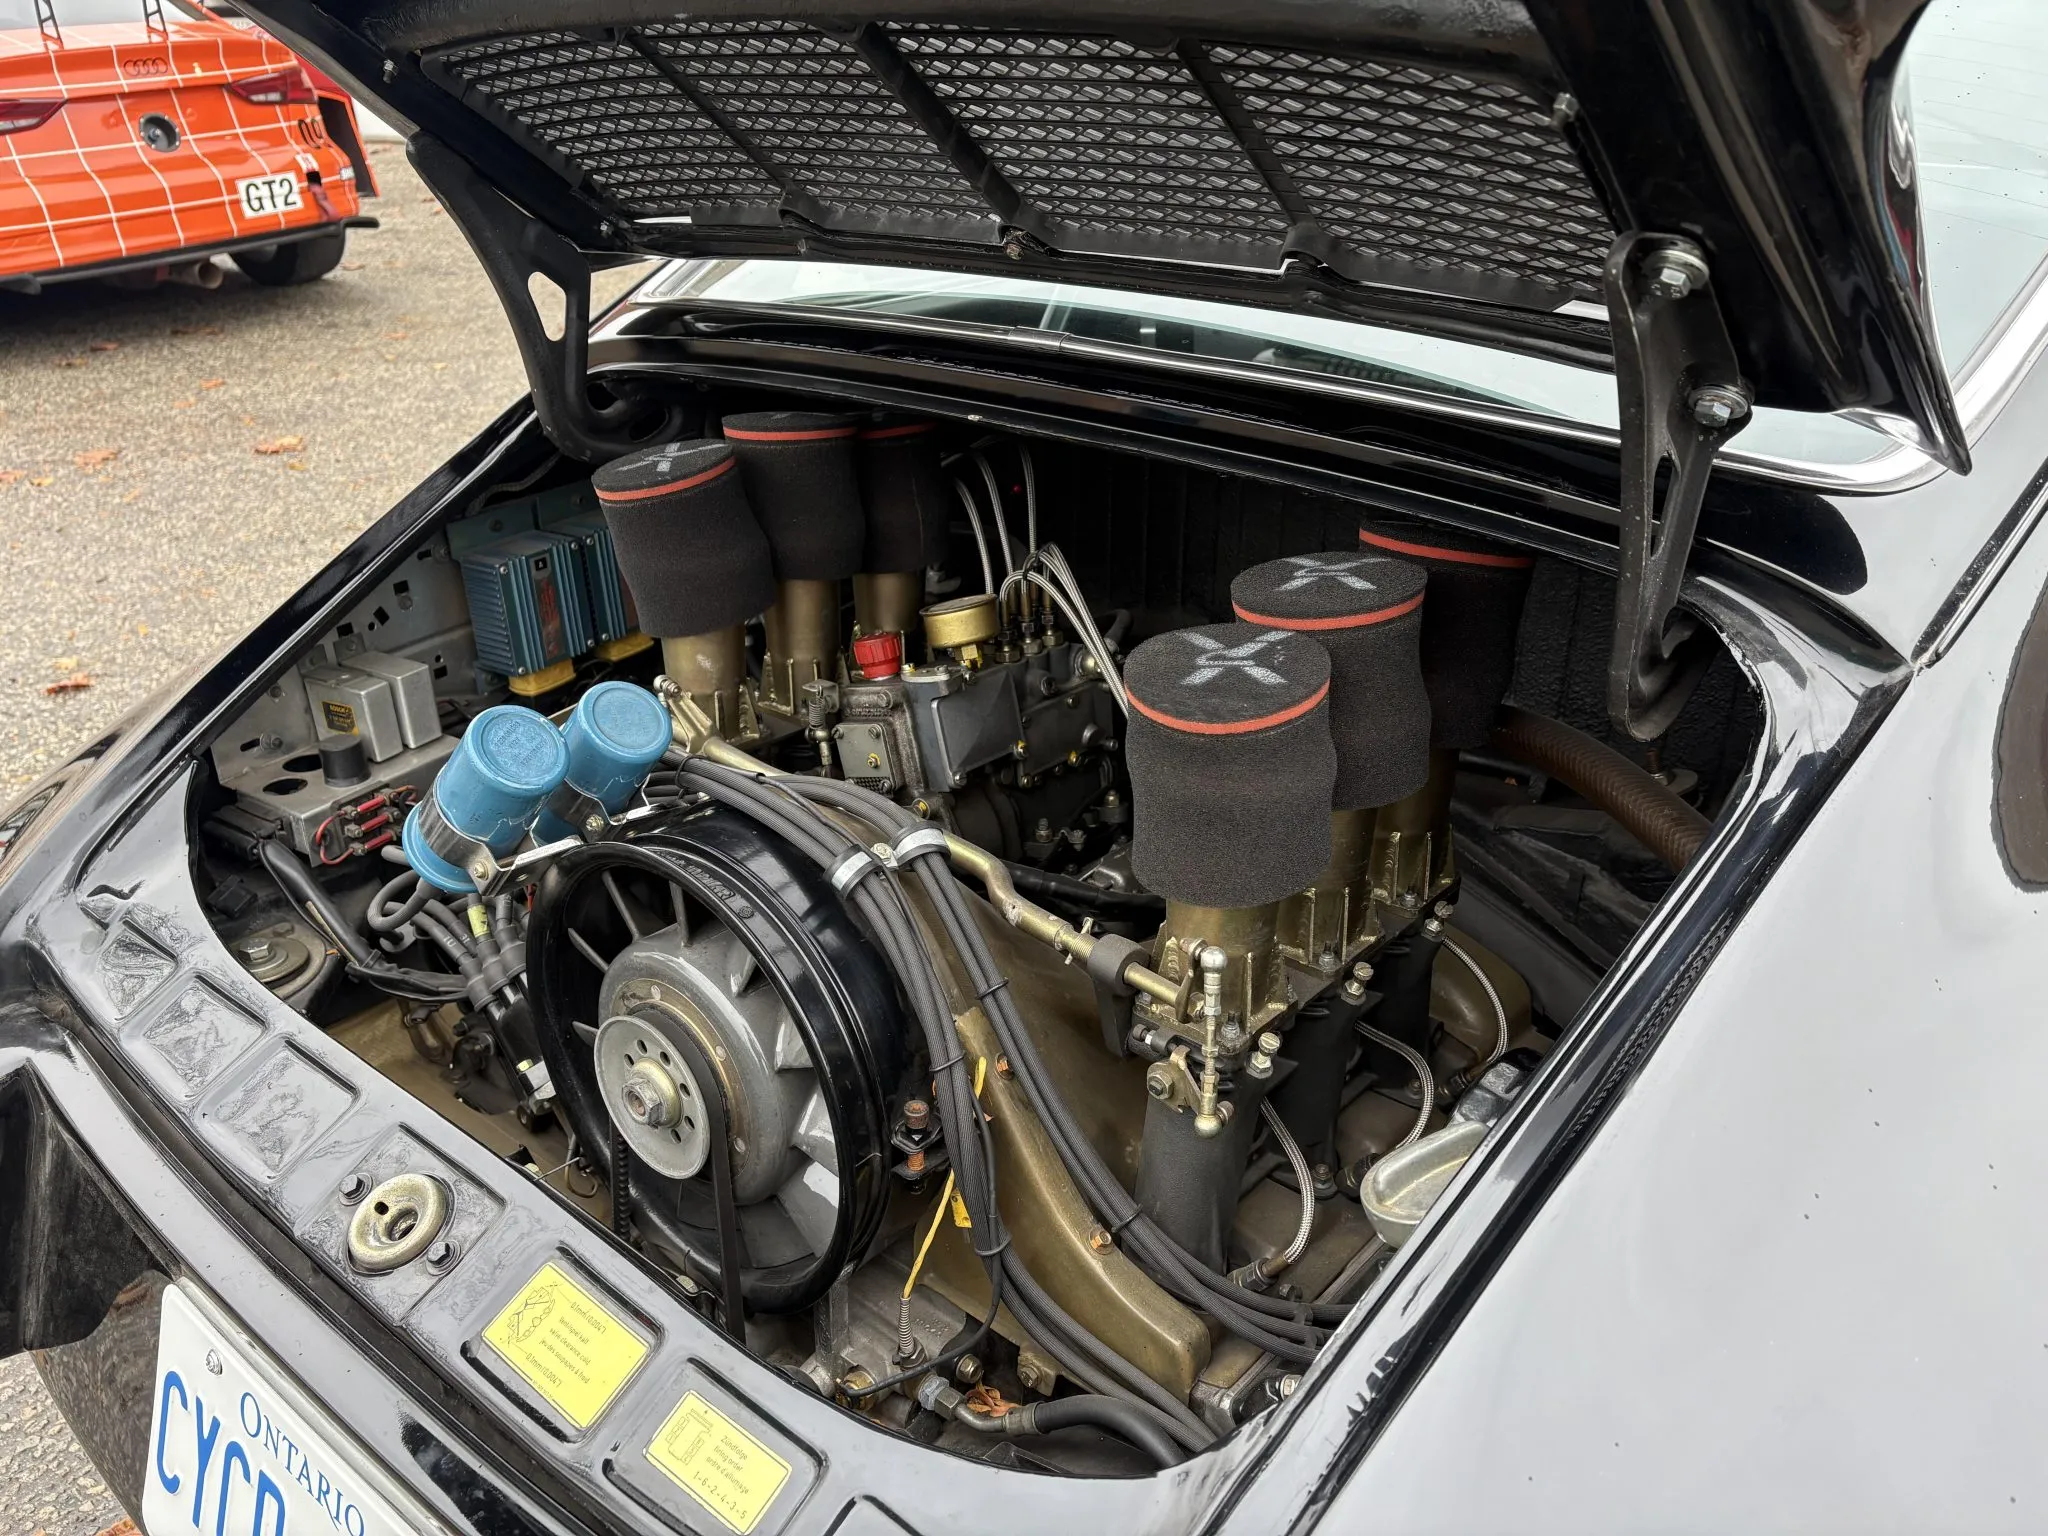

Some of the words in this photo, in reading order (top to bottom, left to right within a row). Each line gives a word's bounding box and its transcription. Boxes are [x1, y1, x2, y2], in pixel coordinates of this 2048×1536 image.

[245, 178, 297, 212] GT2
[240, 1392, 365, 1536] ONTARIO
[706, 1456, 721, 1471] ordre
[713, 1445, 729, 1462] firing
[728, 1458, 743, 1472] order
